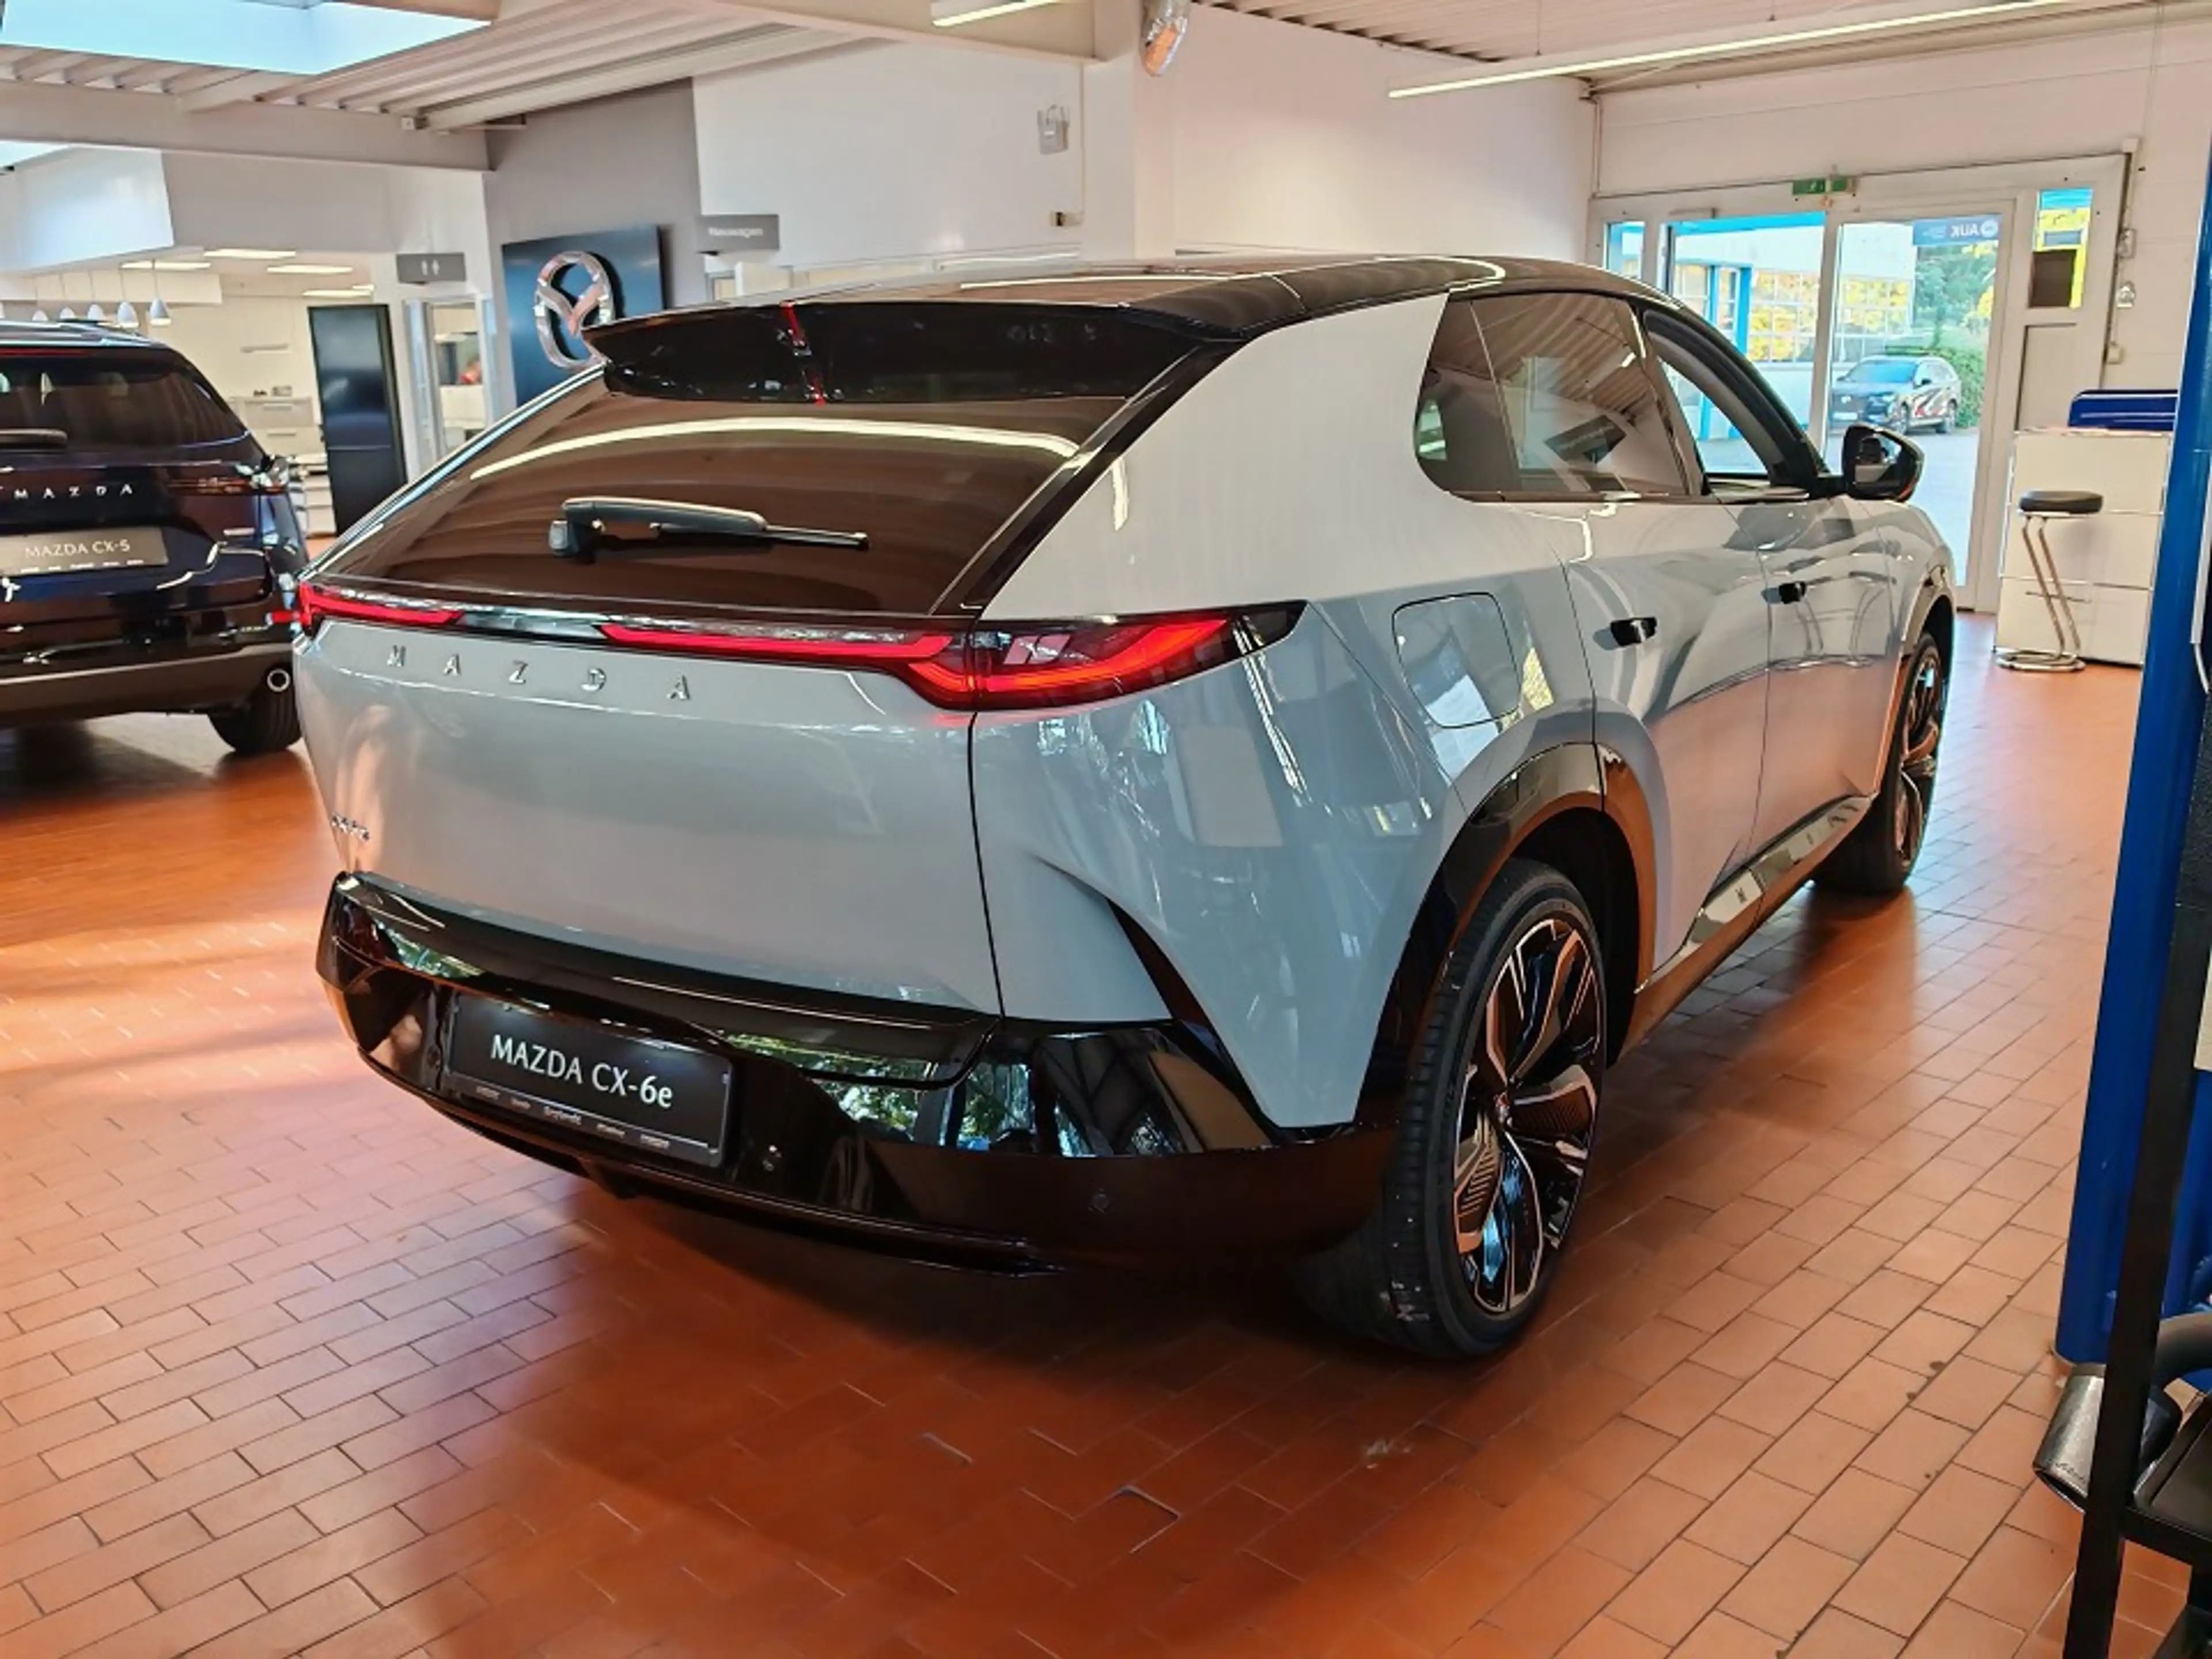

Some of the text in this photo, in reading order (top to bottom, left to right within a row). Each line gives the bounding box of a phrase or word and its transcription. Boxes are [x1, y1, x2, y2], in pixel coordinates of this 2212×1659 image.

[14, 483, 132, 499] MAZDA
[25, 543, 88, 558] MAZDA
[387, 644, 691, 700] MAZDA
[491, 1034, 672, 1108] MAZDA CX-6e
